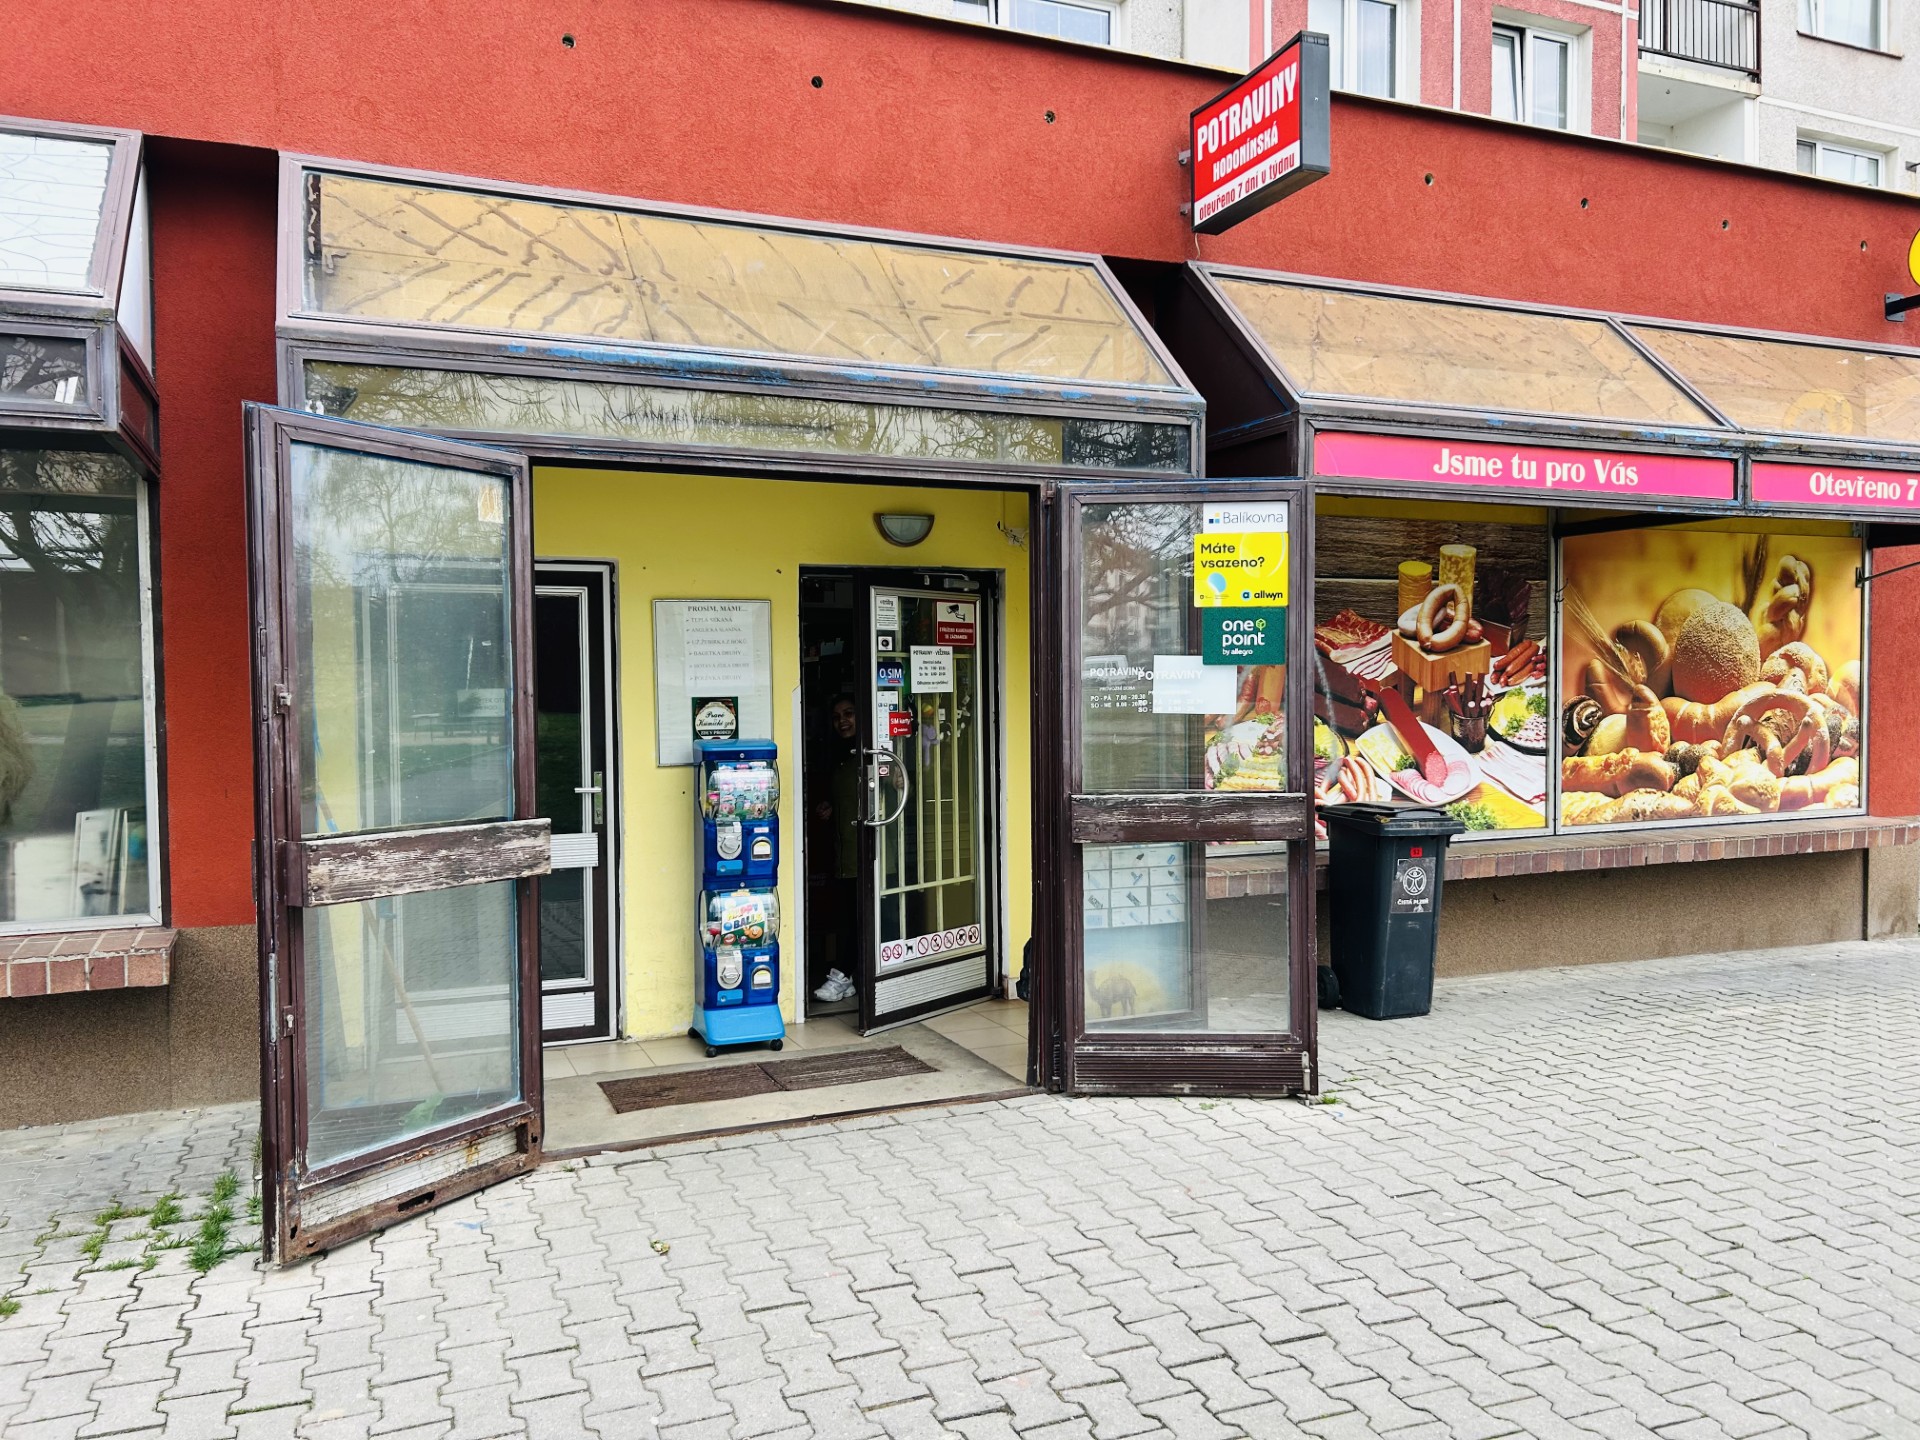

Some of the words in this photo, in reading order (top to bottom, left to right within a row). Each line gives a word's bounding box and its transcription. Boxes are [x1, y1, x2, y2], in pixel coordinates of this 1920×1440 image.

[1197, 62, 1297, 162] POTRAVINY
[1213, 121, 1279, 183] HODONÍNSKÁ
[1199, 189, 1236, 221] otevřeno
[1238, 182, 1244, 201] 7
[1244, 173, 1259, 195] dní
[1261, 173, 1267, 185] v
[1269, 152, 1295, 180] týdnu
[1433, 448, 1503, 478] Jsme
[1511, 452, 1537, 480] tu
[1546, 461, 1586, 487] pro
[1593, 458, 1639, 487] Vás
[1809, 471, 1901, 500] Otevřeno
[1906, 478, 1919, 501] 7
[1222, 511, 1284, 525] Balíkovna
[1200, 542, 1236, 554] Máte
[1200, 556, 1265, 569] vsazeno?
[1254, 590, 1284, 601] allwyn
[1222, 619, 1255, 632] one
[1222, 631, 1265, 647] point
[1222, 648, 1230, 656] by
[1230, 648, 1253, 656] allegro
[888, 668, 902, 678] SIM
[1090, 667, 1145, 677] POTRAVINY
